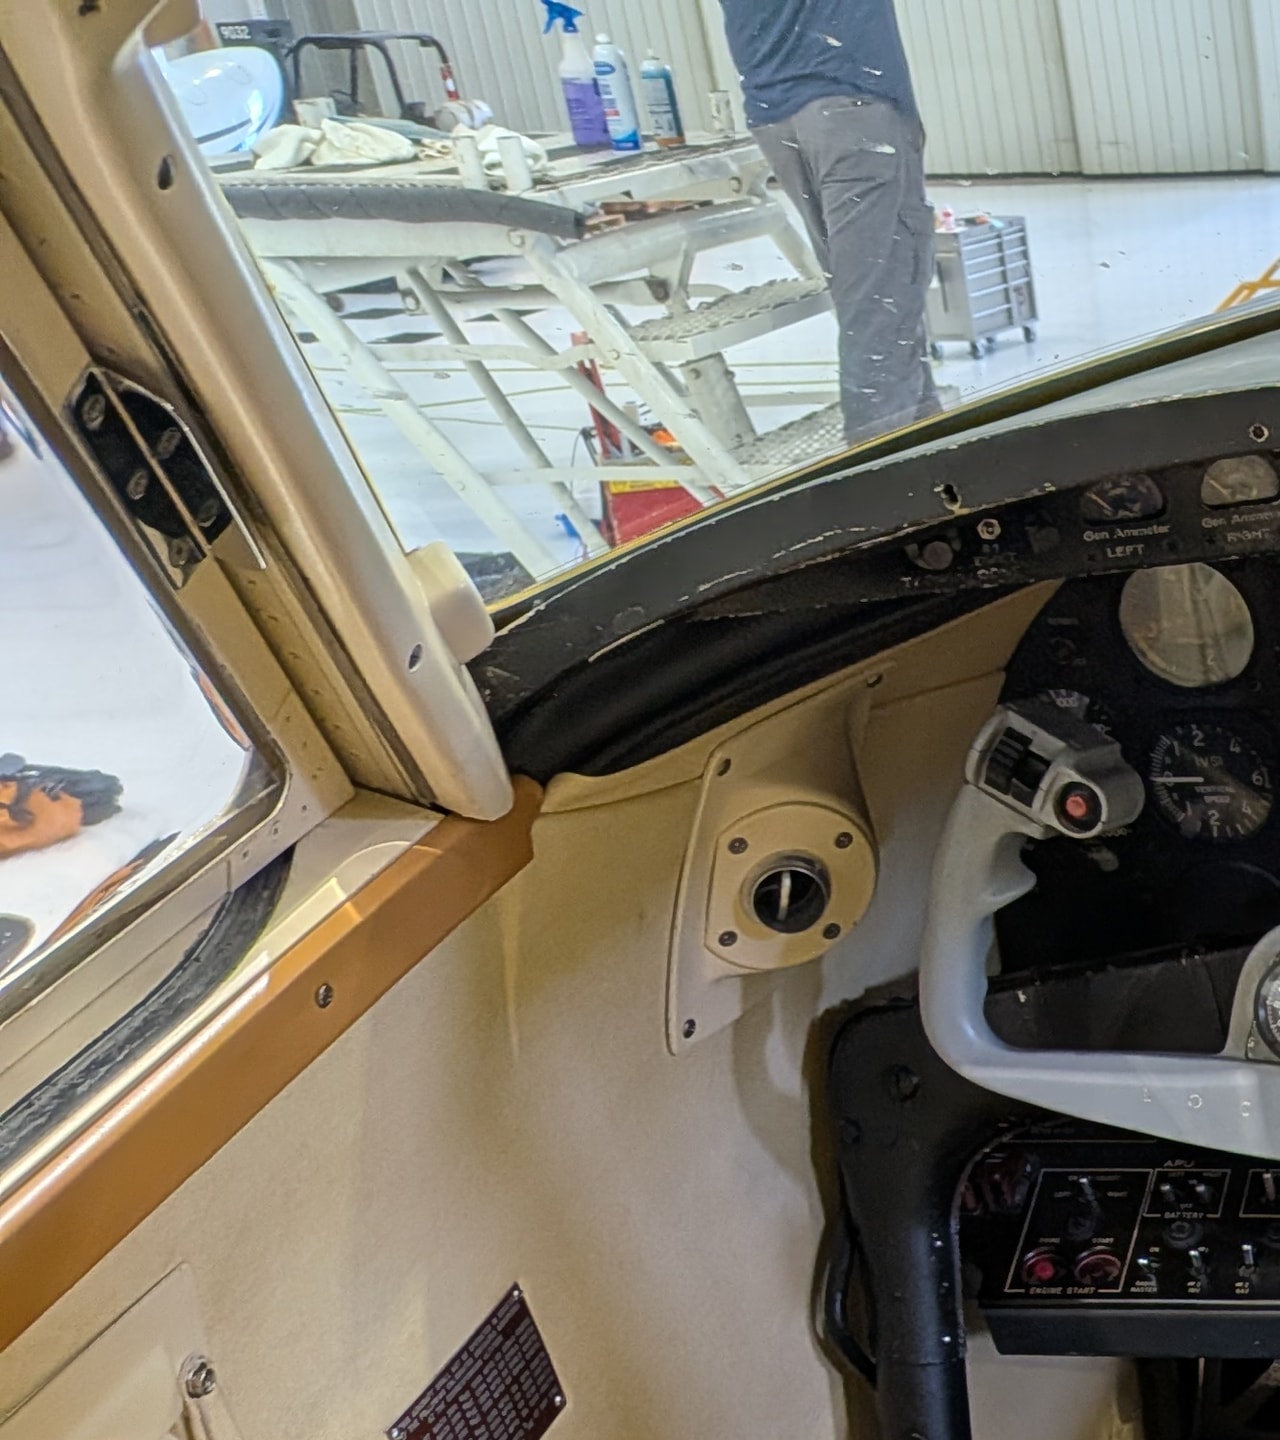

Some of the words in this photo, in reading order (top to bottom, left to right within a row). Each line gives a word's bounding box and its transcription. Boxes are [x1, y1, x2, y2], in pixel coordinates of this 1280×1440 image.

[1082, 529, 1111, 543] Gen
[1106, 543, 1145, 559] LEFT
[1163, 1159, 1195, 1168] APU
[1029, 1286, 1063, 1295] ENGINE
[1065, 1286, 1097, 1295] START
